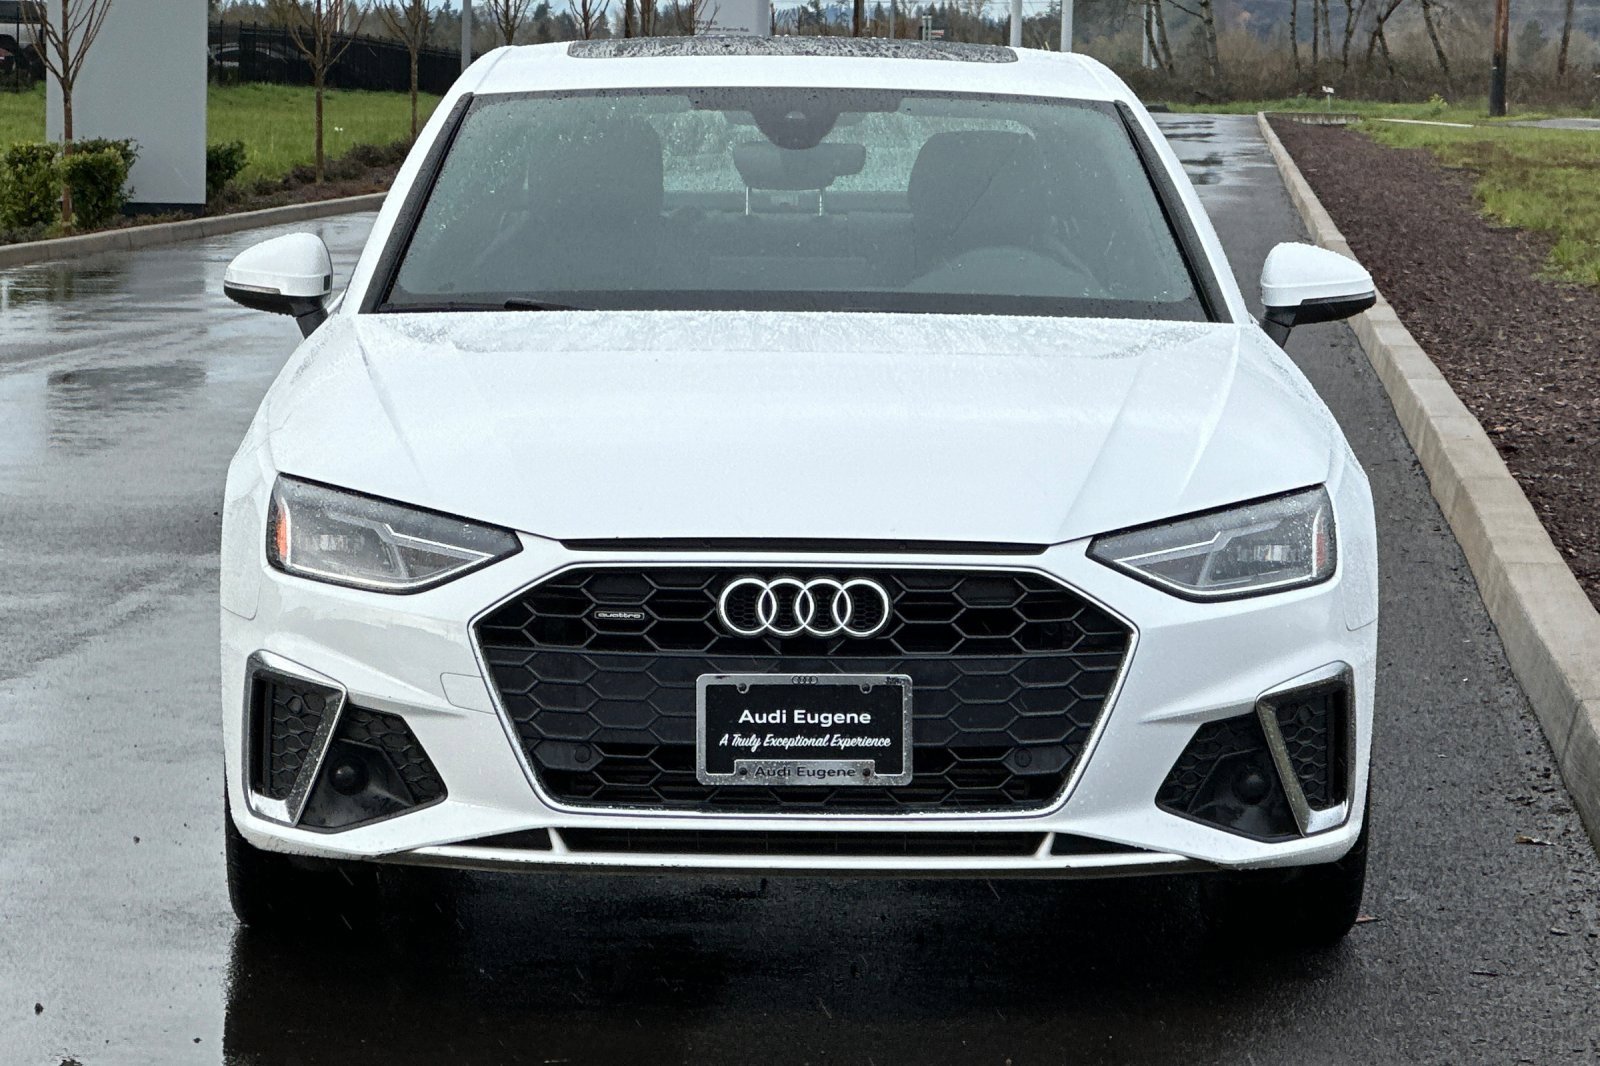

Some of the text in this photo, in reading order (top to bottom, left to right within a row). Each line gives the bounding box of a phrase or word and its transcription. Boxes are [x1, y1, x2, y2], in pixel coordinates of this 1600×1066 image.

[738, 709, 871, 727] Audi Eugene
[719, 734, 891, 752] A Truly Exceptional Experience
[755, 767, 856, 779] Audi Eugene
